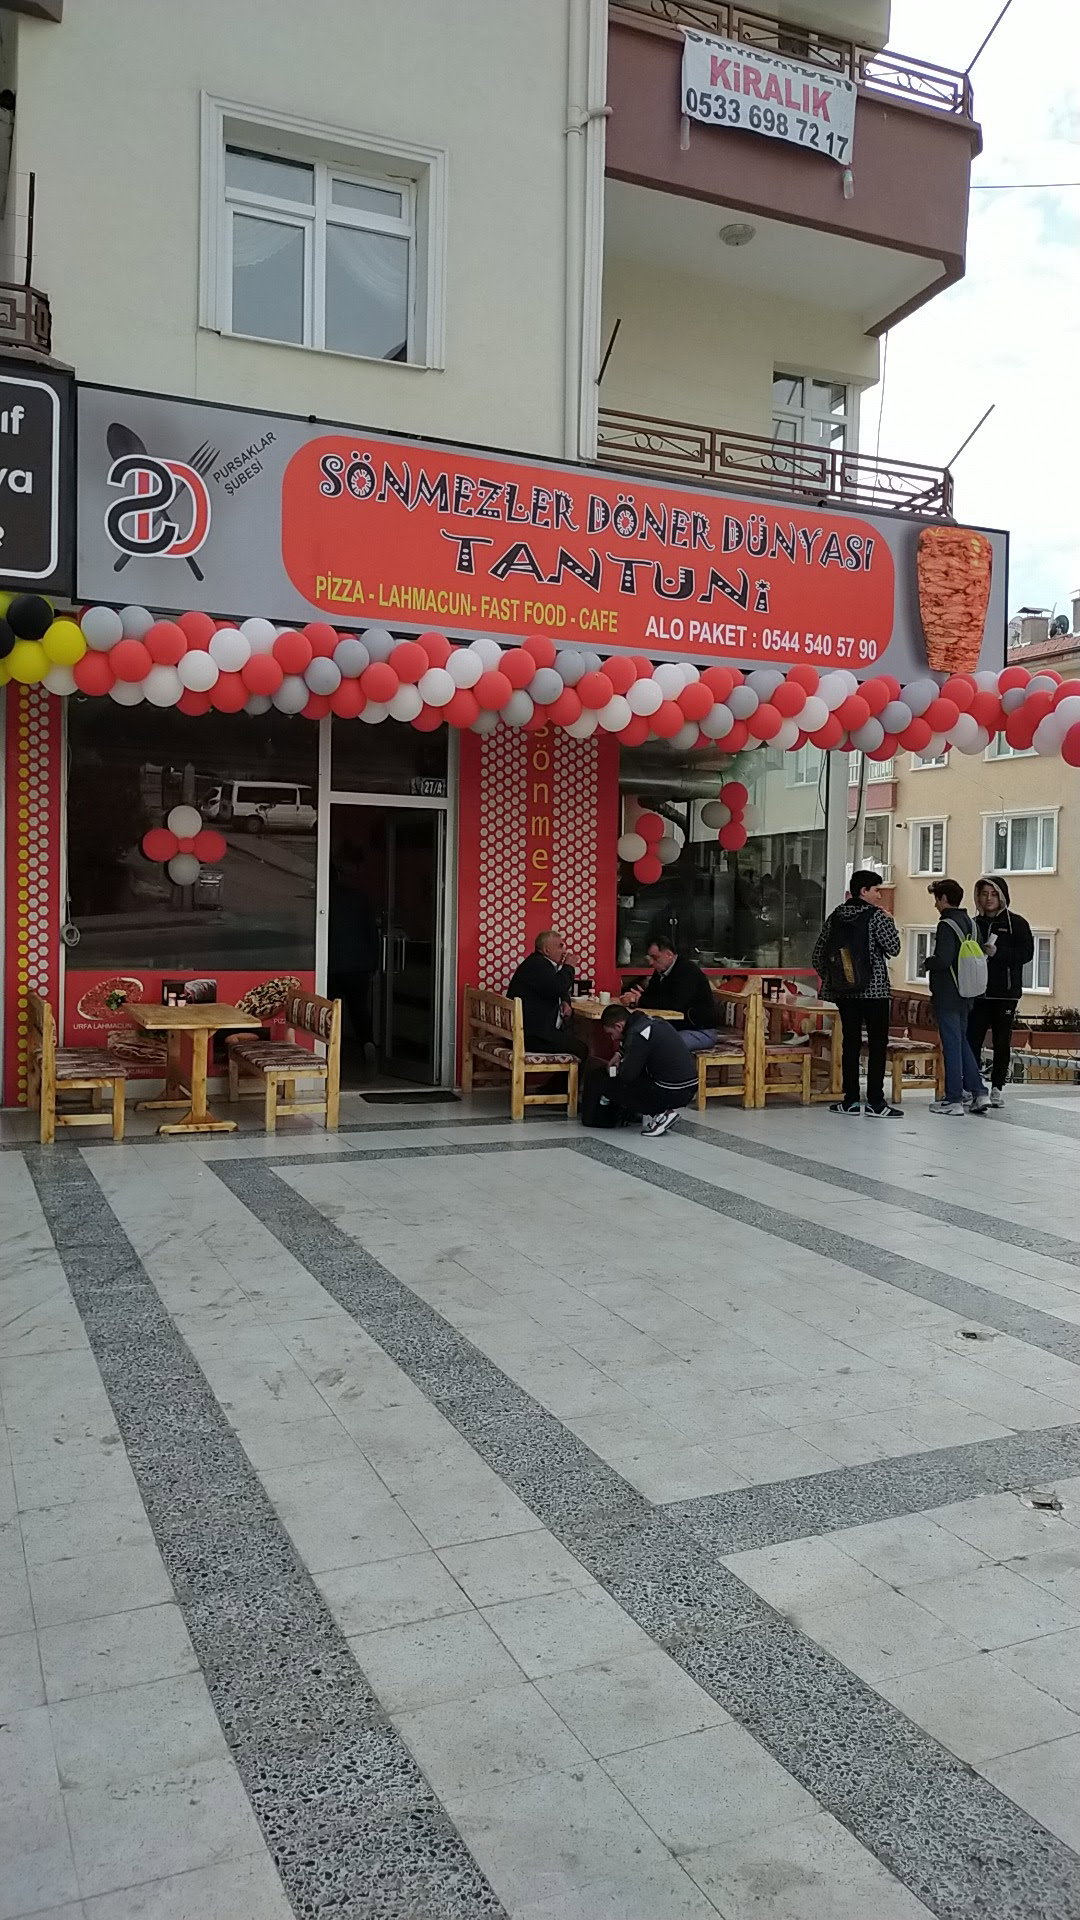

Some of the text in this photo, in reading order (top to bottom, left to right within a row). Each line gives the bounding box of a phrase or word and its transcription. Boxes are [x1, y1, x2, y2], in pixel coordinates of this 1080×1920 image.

[685, 87, 849, 160] 0533 698 72 17
[213, 431, 277, 484] PURSAKLAR
[224, 457, 264, 497] ŞUBESİ
[319, 450, 876, 572] SÖNMEZLER DÖNER DÜNYASI
[315, 571, 365, 604] PİZZA
[480, 595, 520, 622] FAST
[524, 601, 567, 628] FOOD
[579, 607, 619, 633] CAFE
[645, 615, 684, 641] ALO
[689, 620, 748, 648] PAKET
[762, 628, 800, 653] 0544
[804, 633, 832, 656] 540
[836, 637, 855, 659] 57
[859, 638, 878, 661] 90
